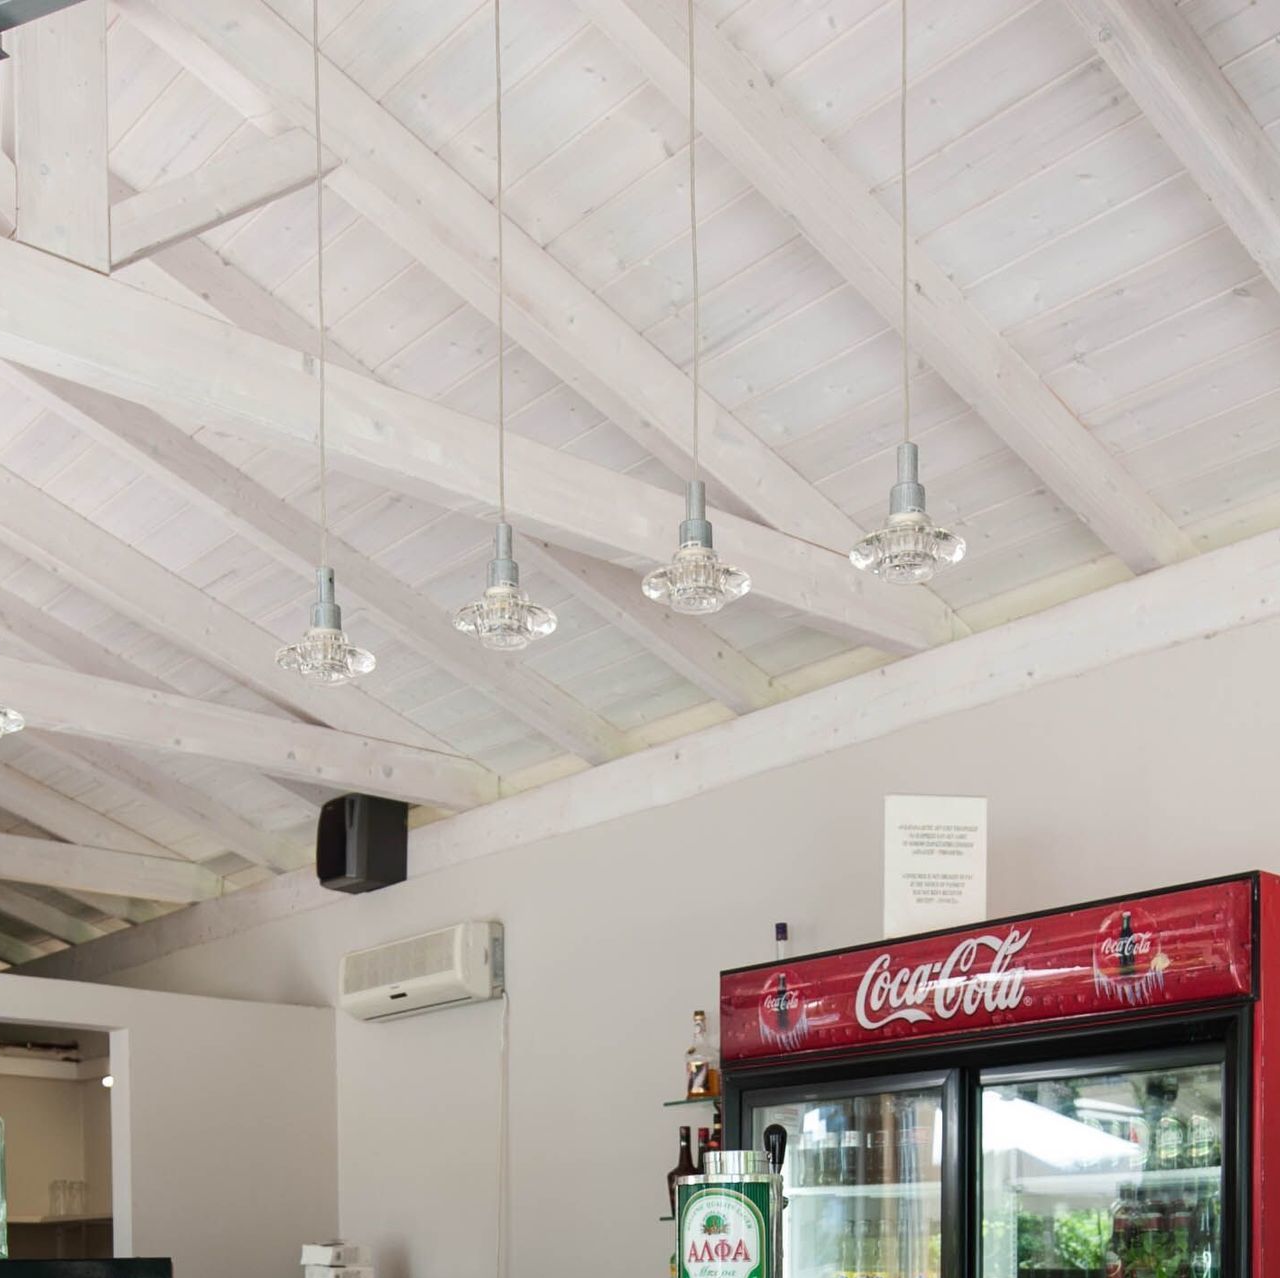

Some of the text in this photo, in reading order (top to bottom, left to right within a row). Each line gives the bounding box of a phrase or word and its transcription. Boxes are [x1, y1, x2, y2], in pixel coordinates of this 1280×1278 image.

[1102, 931, 1152, 959] Coca-Cola
[855, 926, 1032, 1029] Coca-Cola
[688, 1239, 751, 1262] ΑΛΦΑ
